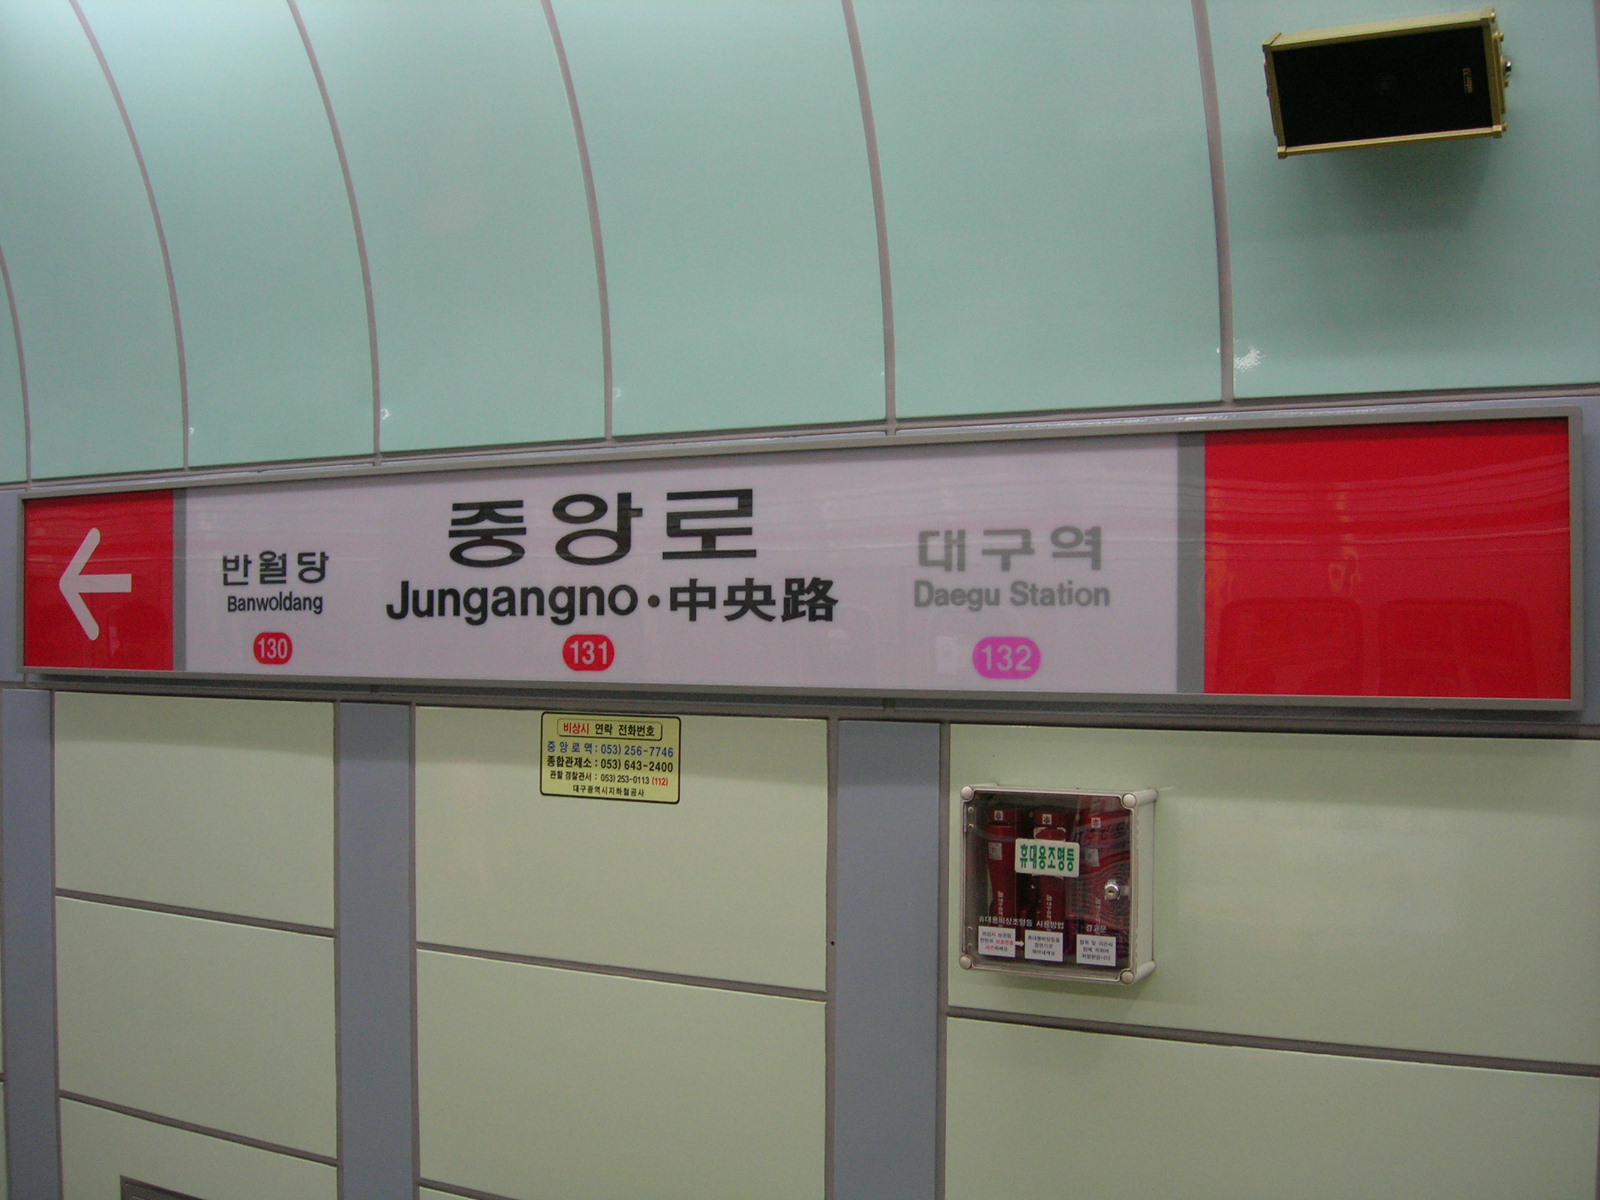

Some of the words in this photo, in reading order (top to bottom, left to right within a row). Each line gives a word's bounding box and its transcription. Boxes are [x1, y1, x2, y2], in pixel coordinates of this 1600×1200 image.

[448, 488, 757, 568] 중앙로
[918, 525, 1102, 572] 대구역
[221, 550, 329, 586] 반월당
[227, 591, 324, 615] Banwoldang
[385, 580, 638, 625] Jungangno
[669, 576, 839, 623] 中央路
[914, 579, 1000, 612] Daegu
[1010, 580, 1111, 607] Station
[257, 638, 288, 660] 130
[569, 641, 609, 665] 131
[981, 645, 1032, 671] 132
[563, 722, 590, 735] 비상시
[595, 723, 613, 736] 연락
[618, 724, 655, 737] 전화번호
[600, 743, 621, 756] 053)
[624, 745, 674, 758] 256-7746
[600, 758, 621, 771] 053)
[624, 760, 674, 773] 643-2400
[617, 774, 650, 785] 253-0113
[651, 776, 669, 787] (112)
[1019, 843, 1075, 872] 휴대용조명등
